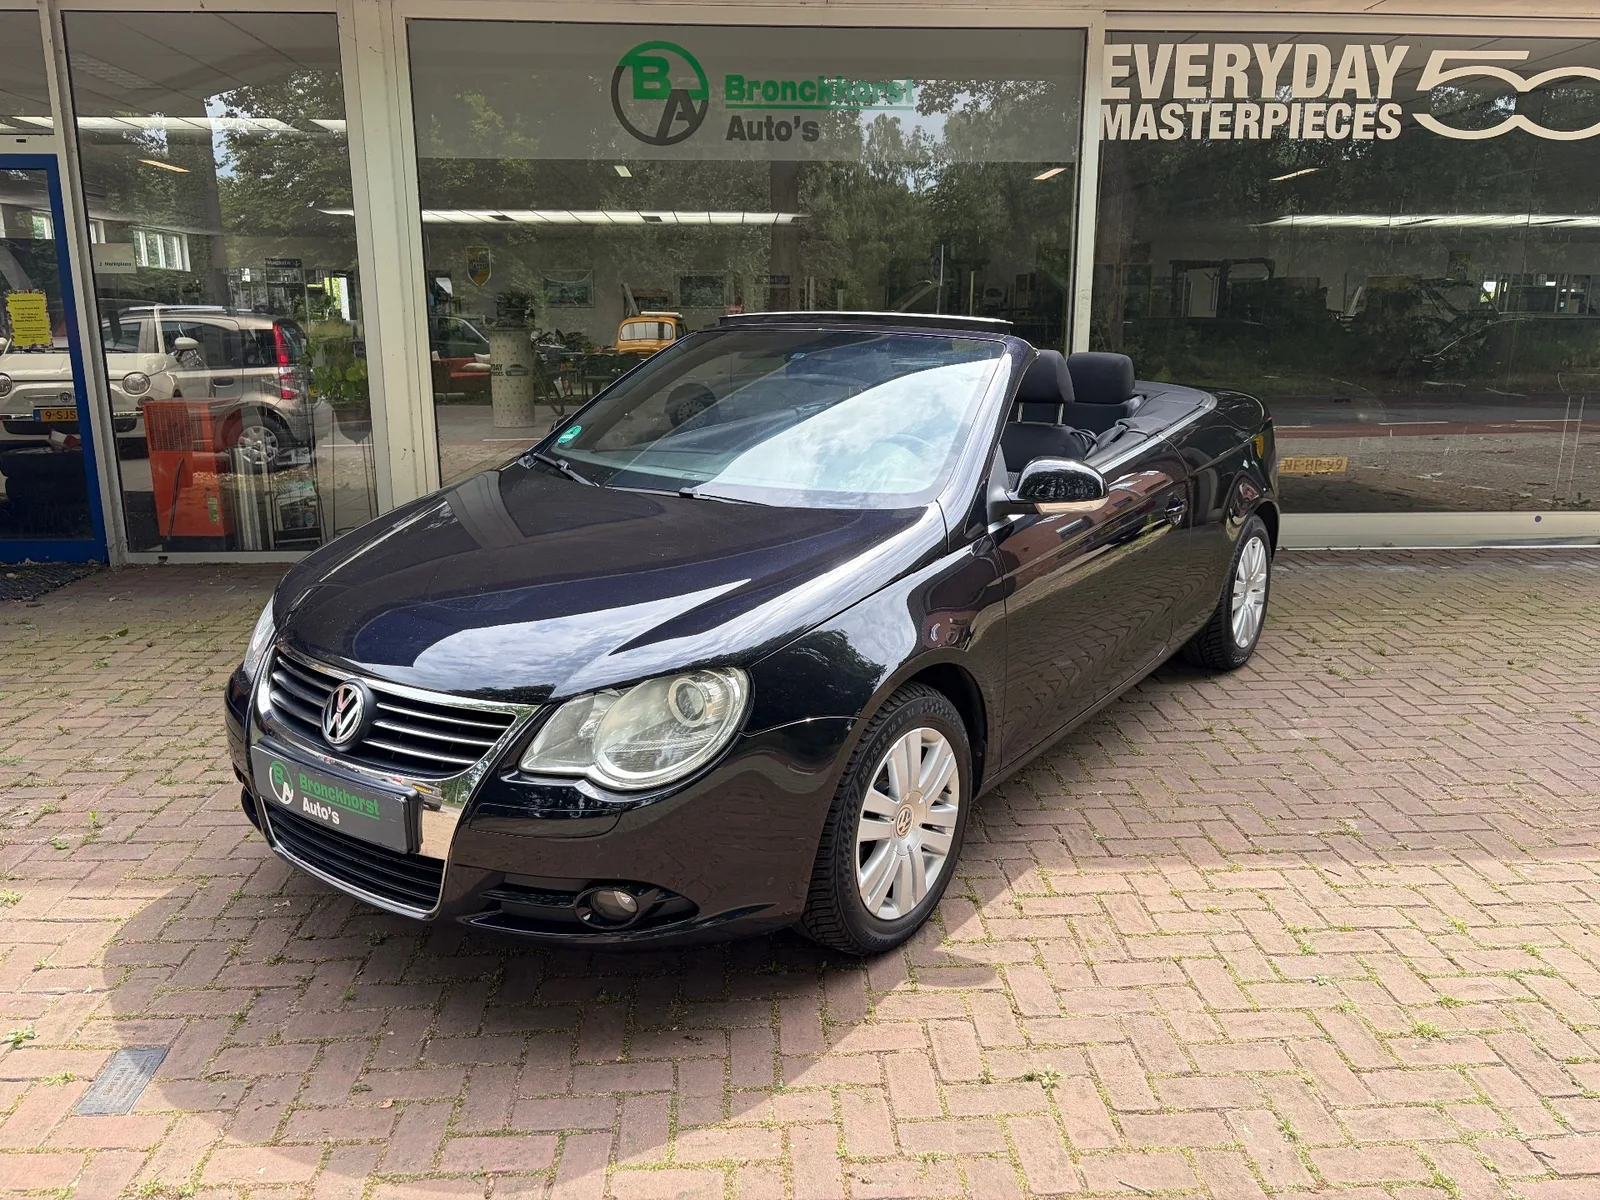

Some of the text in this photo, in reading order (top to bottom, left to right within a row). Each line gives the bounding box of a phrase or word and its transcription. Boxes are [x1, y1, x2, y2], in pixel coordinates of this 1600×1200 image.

[1101, 43, 1411, 100] EVERYDAY
[725, 74, 914, 103] Bronckhorst
[725, 115, 820, 142] Auto's
[1099, 103, 1403, 141] MASTERPIECES
[45, 411, 77, 420] 9-SJS
[298, 772, 381, 816] Bronckhorst
[302, 796, 340, 825] Auto's
